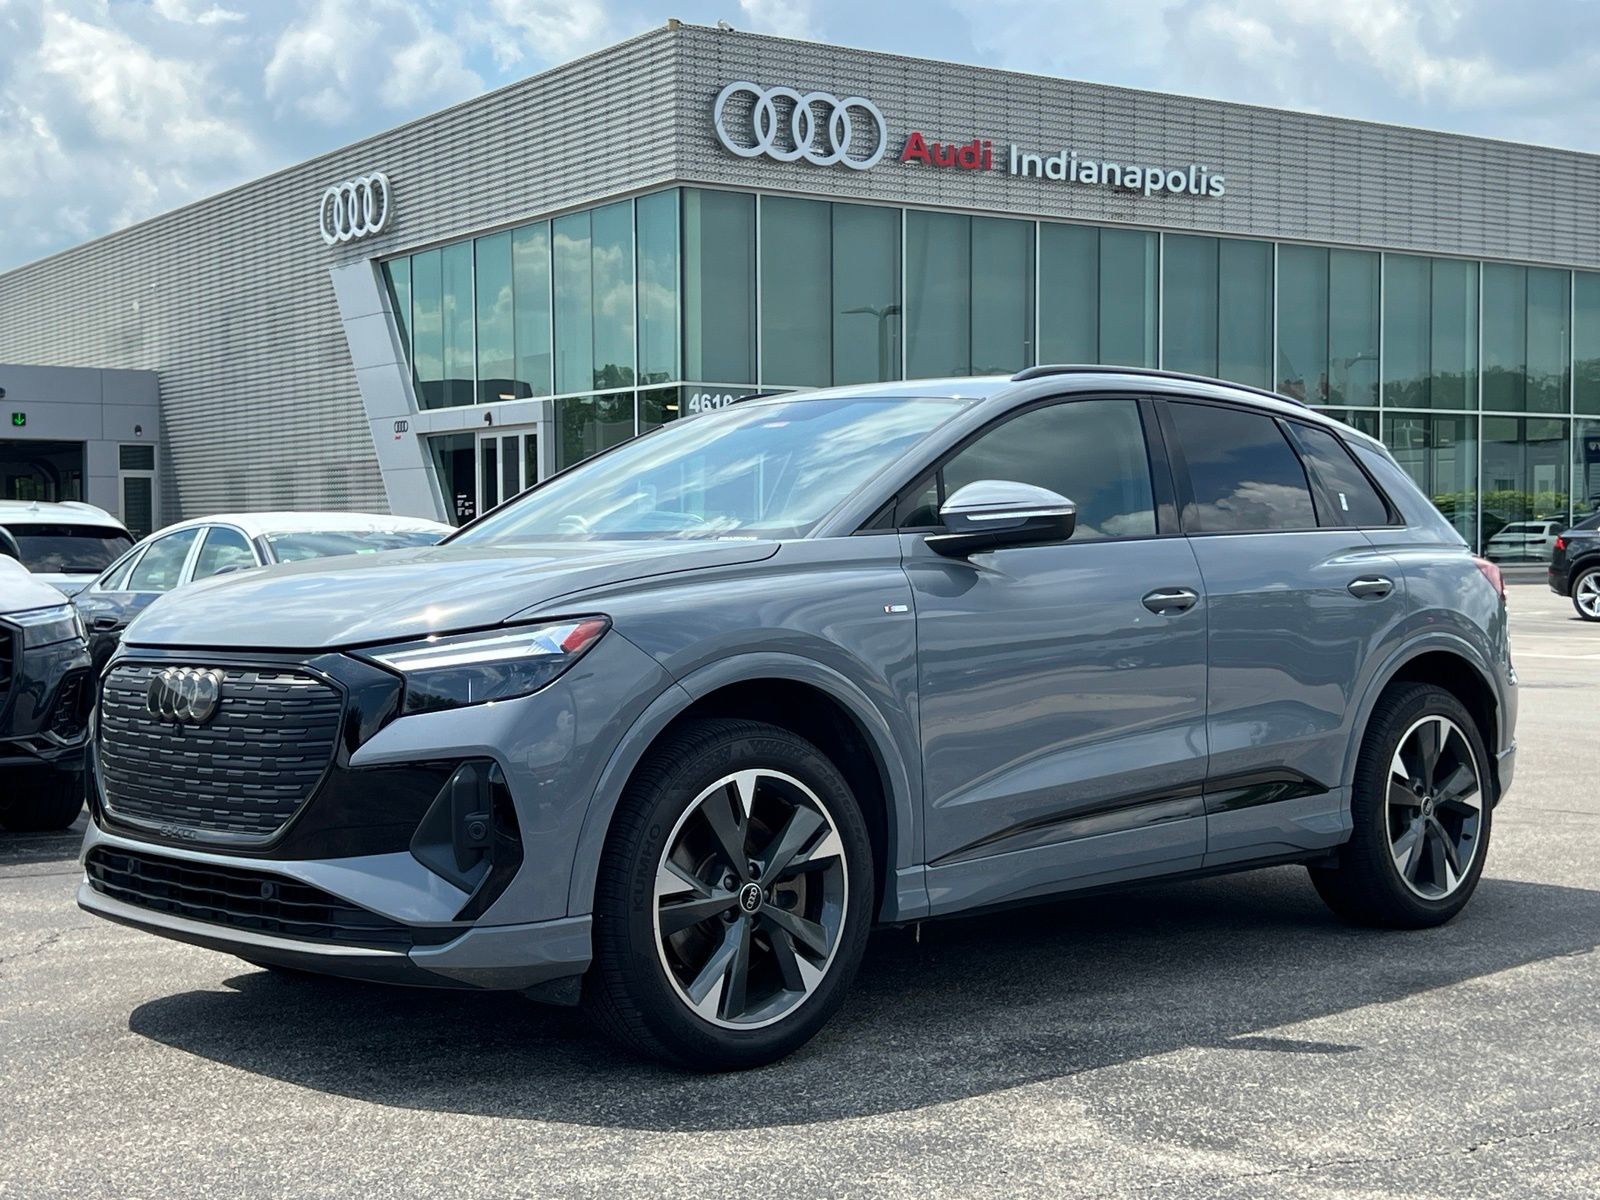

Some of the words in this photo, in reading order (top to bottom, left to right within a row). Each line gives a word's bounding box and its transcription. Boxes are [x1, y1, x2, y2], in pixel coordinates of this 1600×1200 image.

[903, 132, 992, 171] Audi
[1009, 143, 1225, 197] Indianapolis
[633, 823, 661, 912] KUMHO
